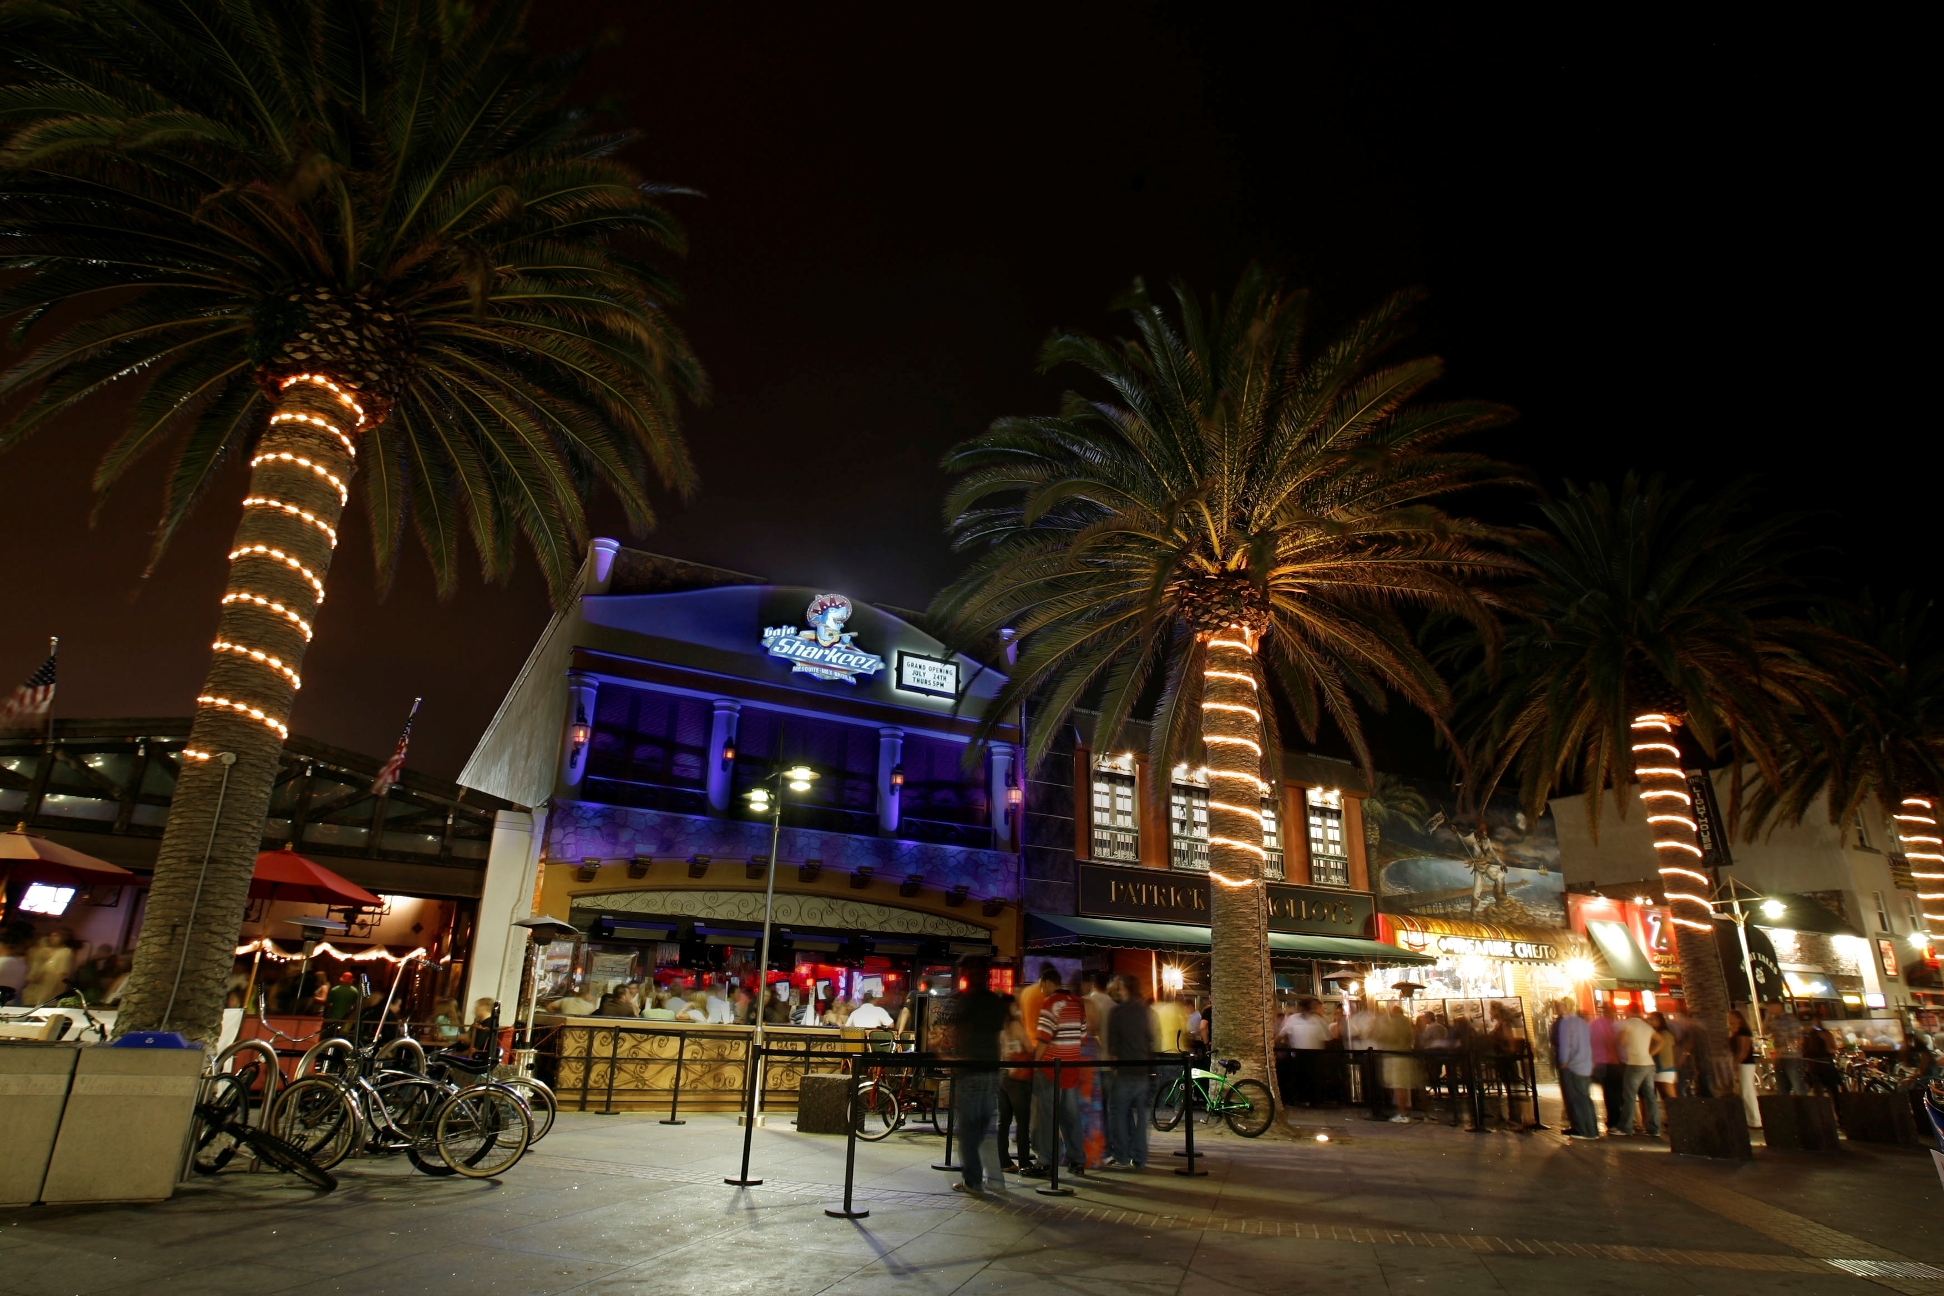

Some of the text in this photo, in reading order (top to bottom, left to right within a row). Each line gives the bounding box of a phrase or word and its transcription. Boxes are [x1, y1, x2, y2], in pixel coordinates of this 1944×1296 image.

[773, 638, 878, 670] Sharkeez
[906, 661, 954, 676] GRAND OPENING
[911, 669, 947, 682] JULY 24TH
[912, 676, 945, 689] THURS 5PM
[1693, 786, 1713, 850] LIGHTHOUSE
[1109, 879, 1207, 912] PATRICK
[1452, 938, 1514, 957] TREASURE
[1515, 942, 1550, 959] CHEST
